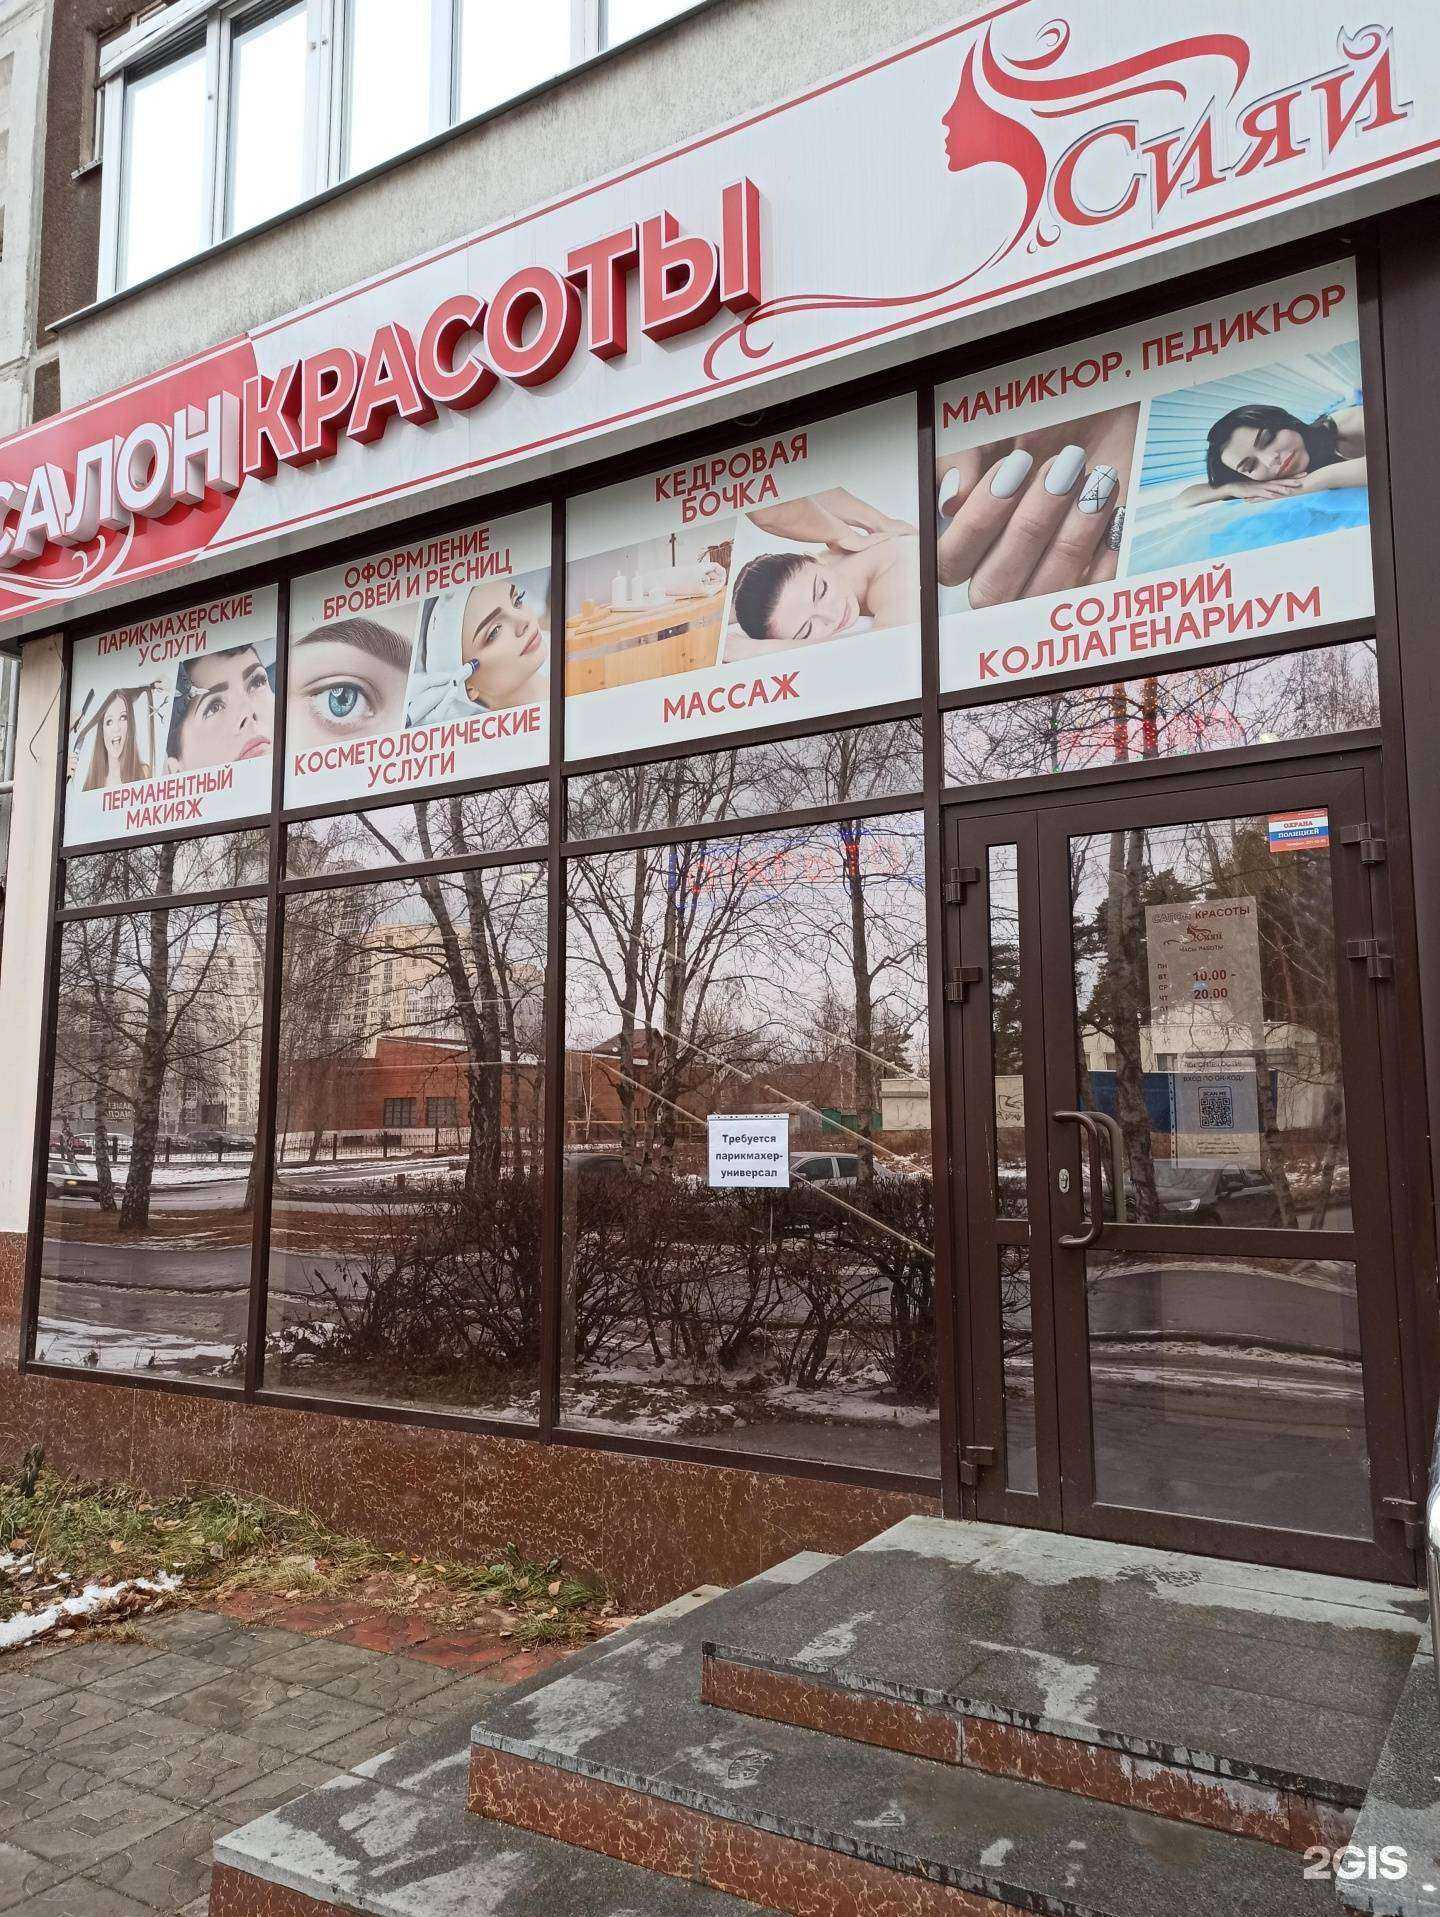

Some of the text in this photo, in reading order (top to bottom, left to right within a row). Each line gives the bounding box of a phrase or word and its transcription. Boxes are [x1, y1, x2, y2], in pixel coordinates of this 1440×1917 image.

[242, 177, 761, 478] КРАСОТЫ
[942, 284, 1346, 429] МАНИКЮР, ПЕДИКЮР
[655, 433, 808, 502] КЕДРОВАЯ
[682, 474, 779, 523] БОЧКА
[344, 527, 490, 589] ОФОРМЛЕНИЕ
[324, 549, 512, 620] БРОВЕЙ И РЕСНИЦ
[1050, 564, 1232, 632] СОЛЯРИЙ
[97, 595, 253, 655] ПАРИКМАХЕРСКИЕ
[138, 631, 207, 667] УСЛУГИ
[979, 586, 1321, 680] КОЛЛАГЕНАРИУМ
[663, 671, 800, 723] МАССАЖ
[294, 707, 541, 777] КОСМЕТОЛОГИЧЕСКИЕ
[102, 765, 233, 812] ПЕРМАНЕНТНЫЙ
[368, 751, 455, 788] УСЛУГИ
[126, 798, 204, 830] МАКИЯЖ
[1278, 827, 1320, 839] ПОЛИЦИЕЙ
[1195, 906, 1250, 919] КРАСОТЫ
[1193, 970, 1227, 981] 10.00
[1194, 988, 1228, 999] 20.00
[715, 1152, 783, 1162] парикмахер-
[722, 1134, 777, 1145] Требуется
[721, 1169, 777, 1179] универсал
